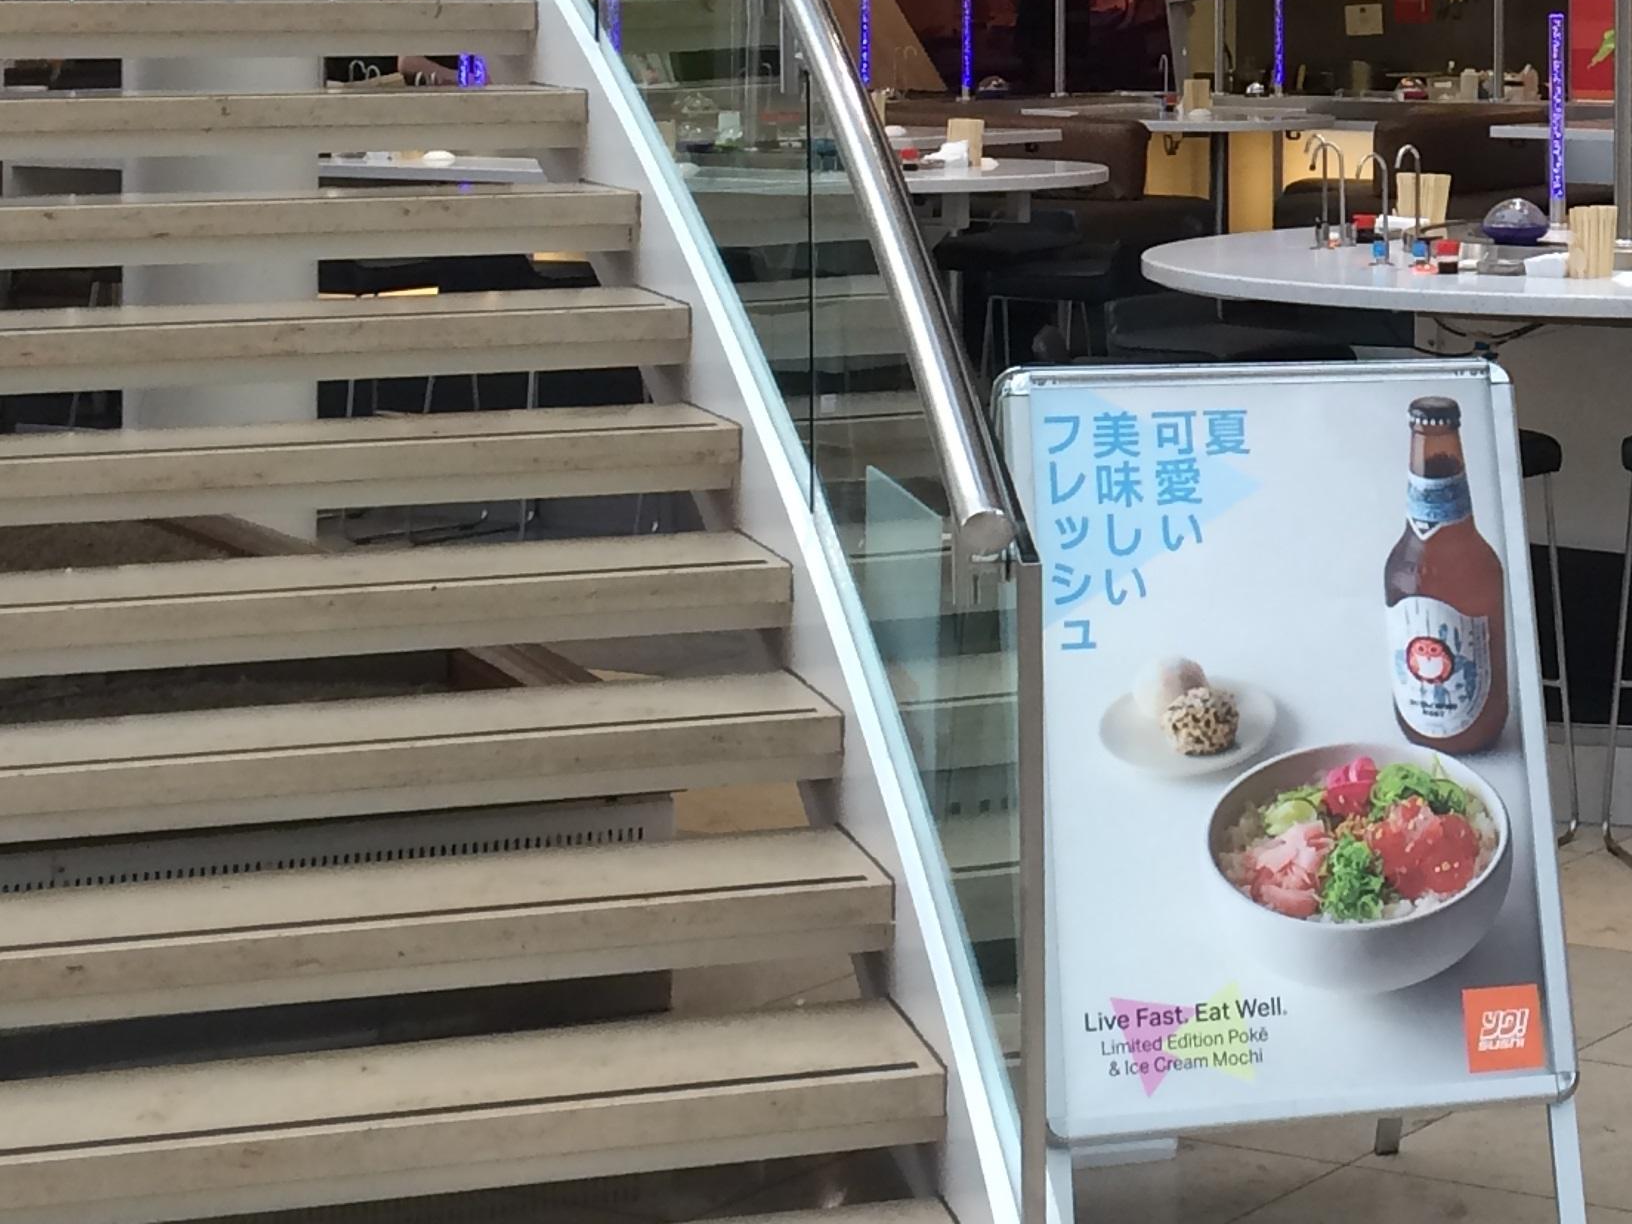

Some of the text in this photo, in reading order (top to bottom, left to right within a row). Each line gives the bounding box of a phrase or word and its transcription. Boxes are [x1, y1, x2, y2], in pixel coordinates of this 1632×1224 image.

[1203, 409, 1251, 456] 夏
[1151, 409, 1204, 553] 可愛い
[1092, 411, 1147, 607] 美味しい
[1043, 414, 1097, 651] フレッシュ
[1085, 996, 1288, 1032] Live Fast. Eat Well.
[1479, 1008, 1530, 1039] YO!
[1101, 1036, 1163, 1056] Limited
[1167, 1030, 1224, 1051] Edition
[1108, 1048, 1264, 1077] & Ice Cream Mochi
